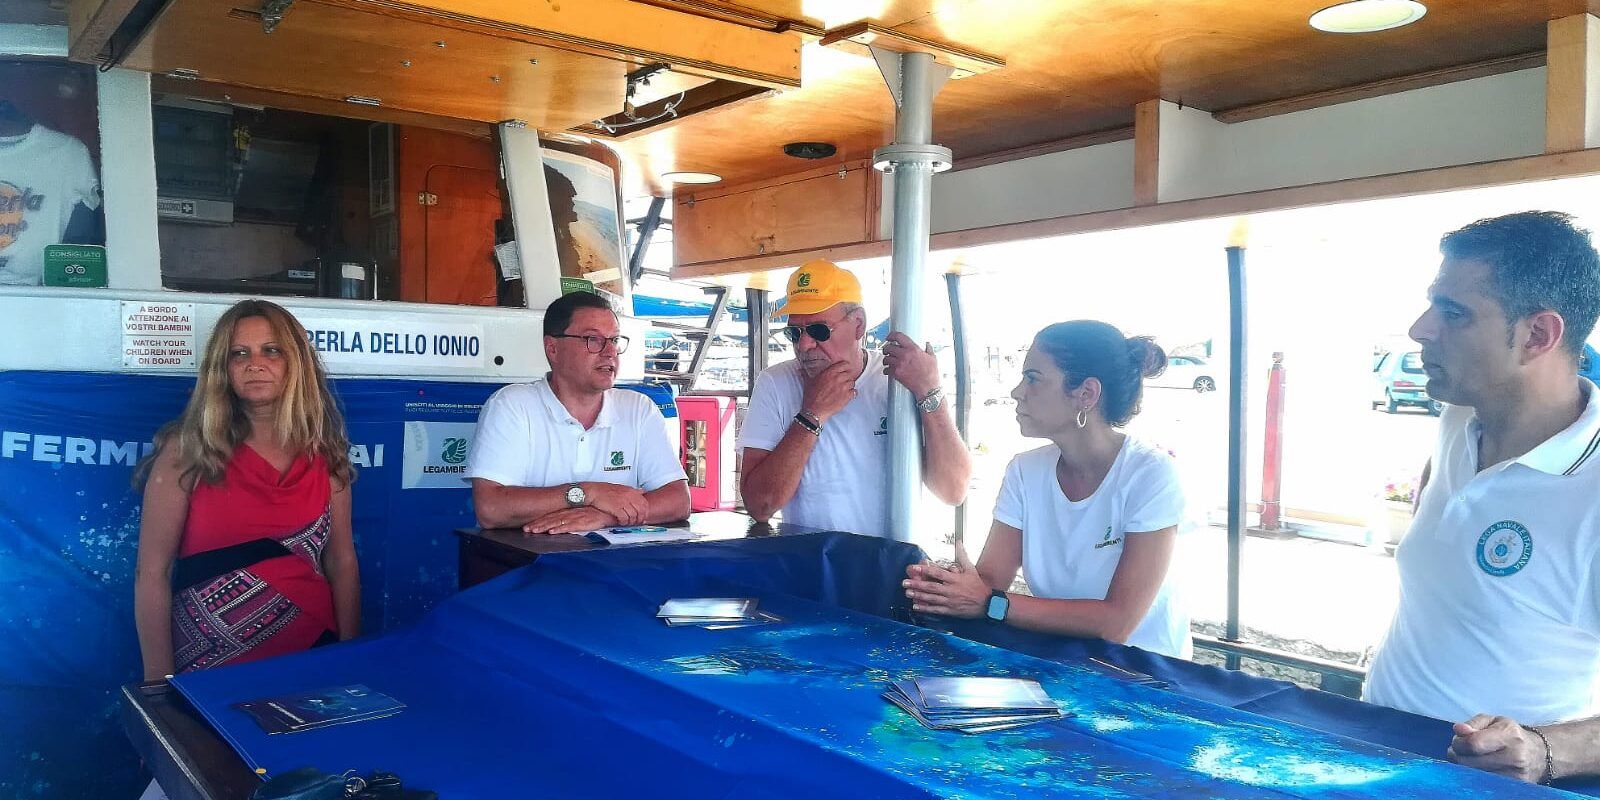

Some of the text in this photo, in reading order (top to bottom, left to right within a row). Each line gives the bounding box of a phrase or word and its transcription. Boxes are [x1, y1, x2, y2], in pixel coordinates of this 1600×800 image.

[49, 250, 101, 258] CONSIGLIATO
[305, 330, 480, 357] PERLA DELLO IONIO
